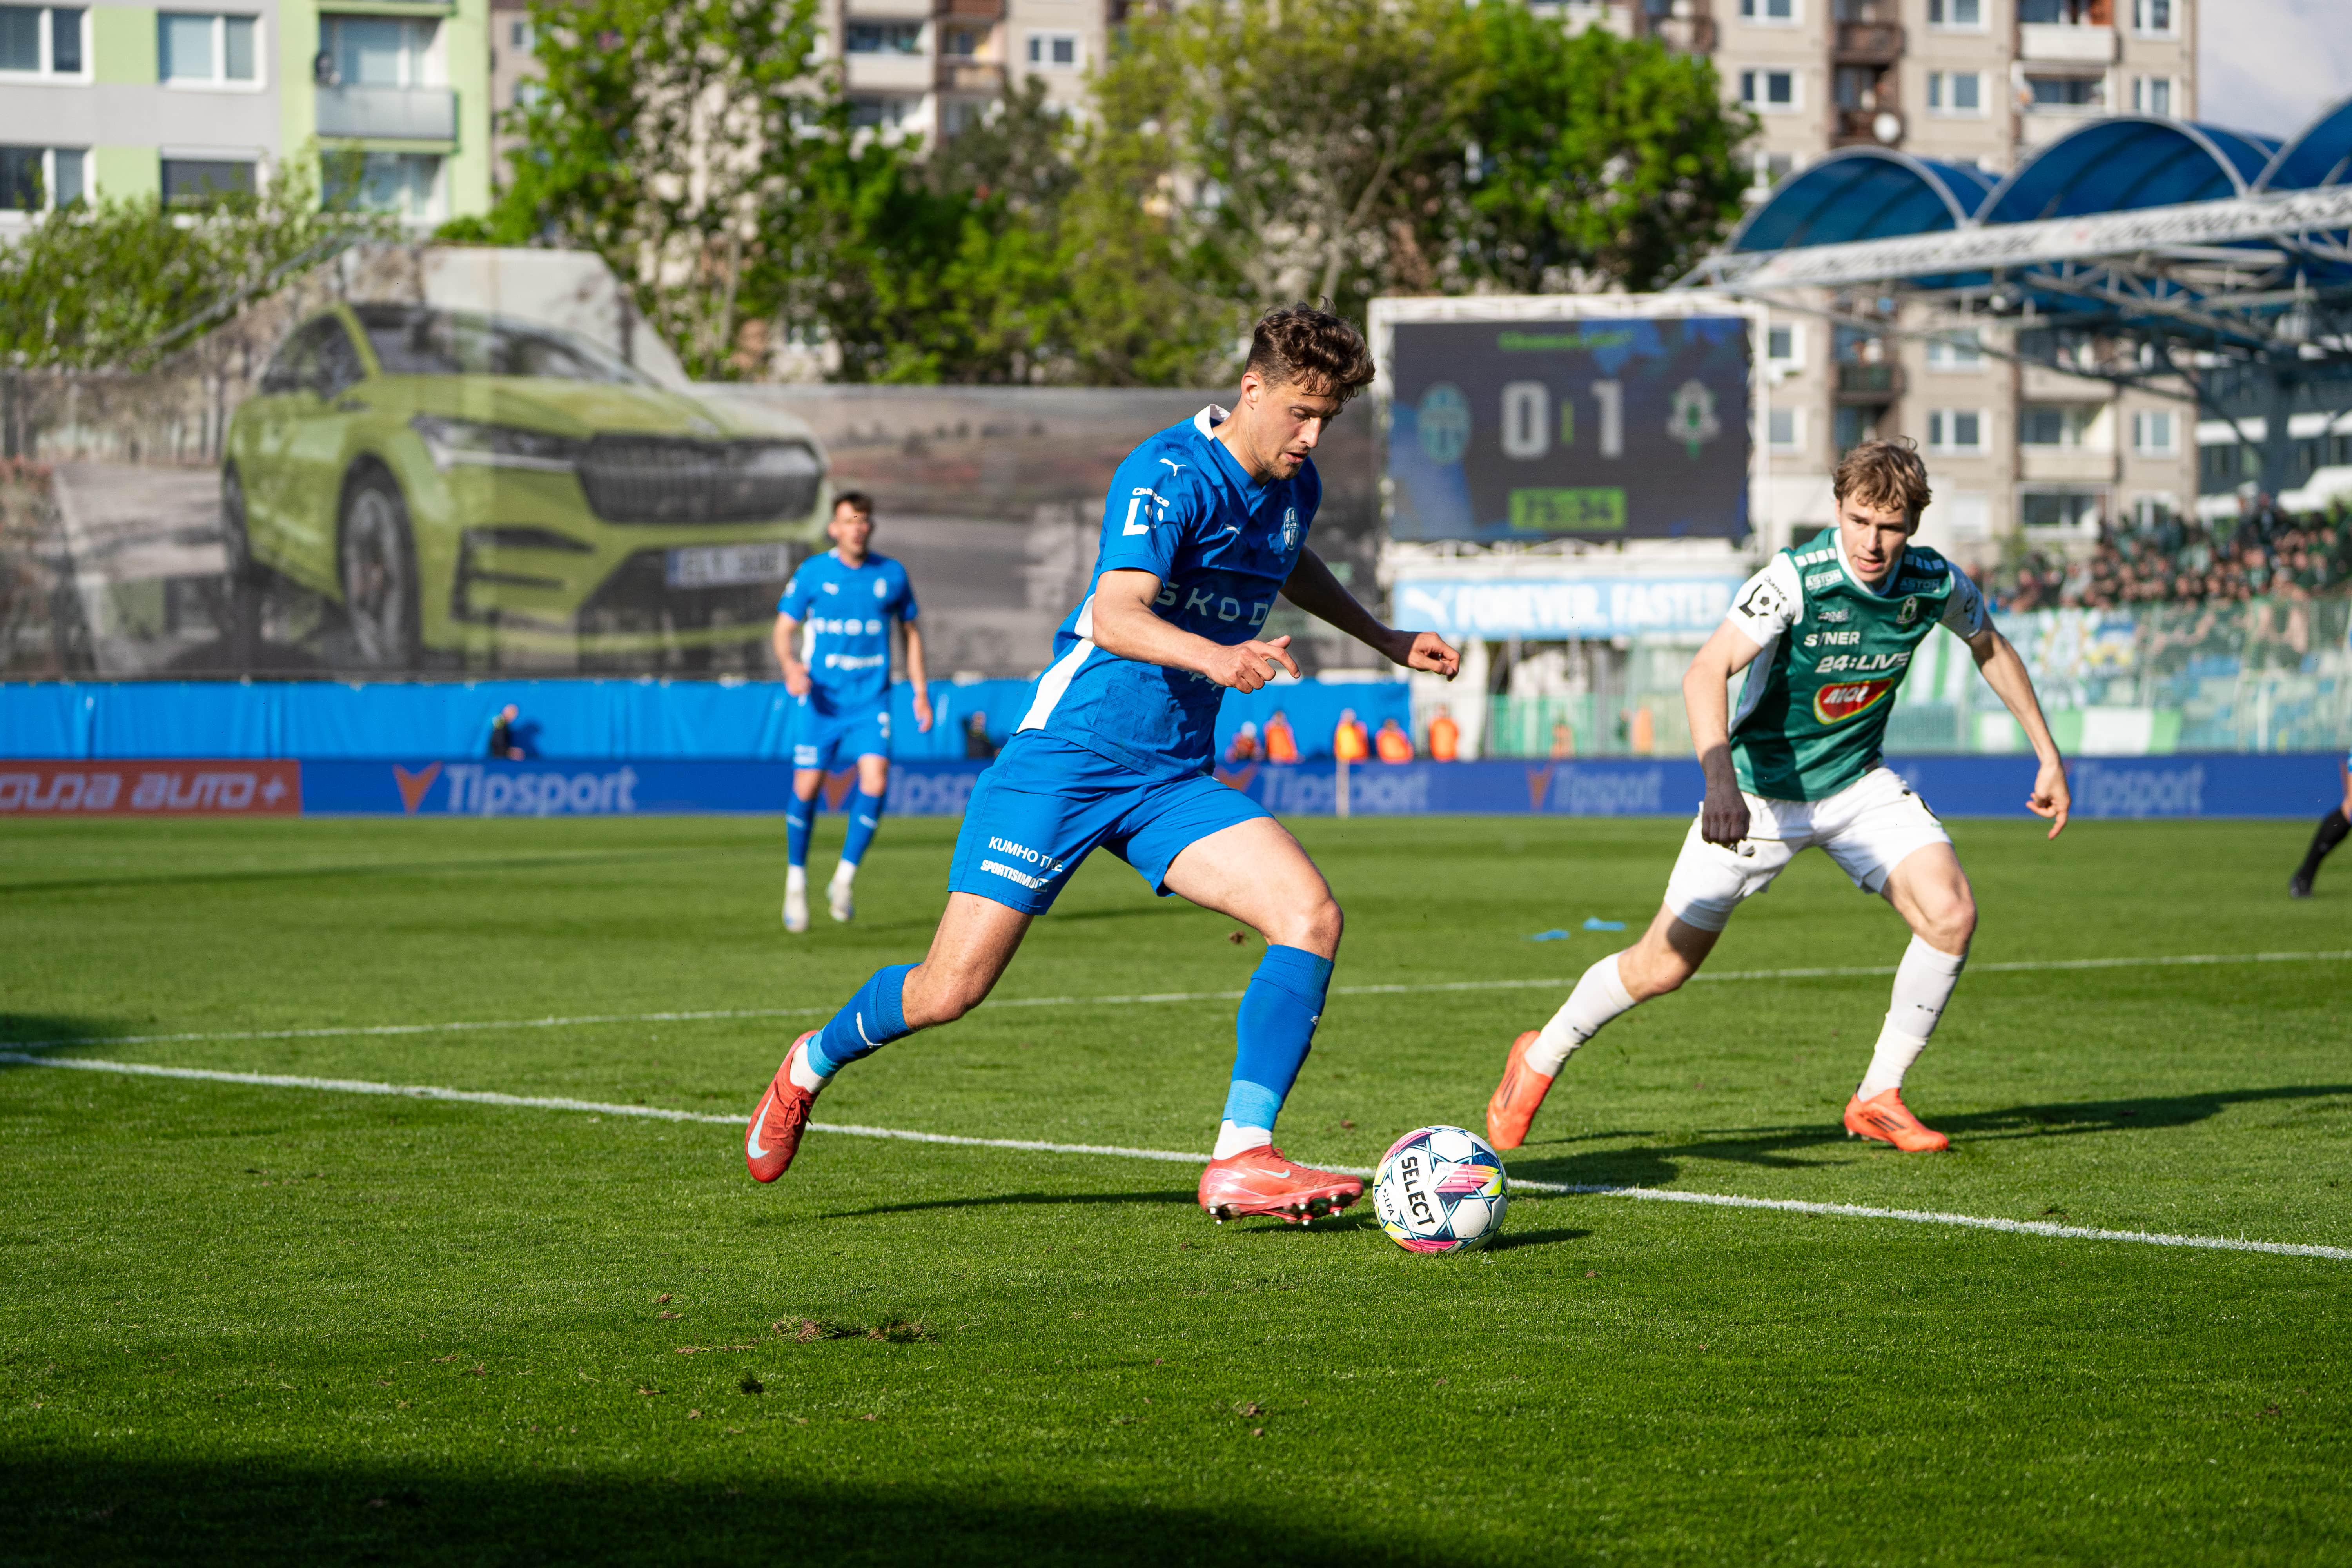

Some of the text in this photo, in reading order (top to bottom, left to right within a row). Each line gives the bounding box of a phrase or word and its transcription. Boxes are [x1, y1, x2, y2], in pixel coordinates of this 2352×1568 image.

[1499, 379, 1623, 460] 0 1
[445, 764, 637, 817] Tipsport
[988, 837, 1038, 863] KUMHO
[1401, 1156, 1435, 1225] SELECT
